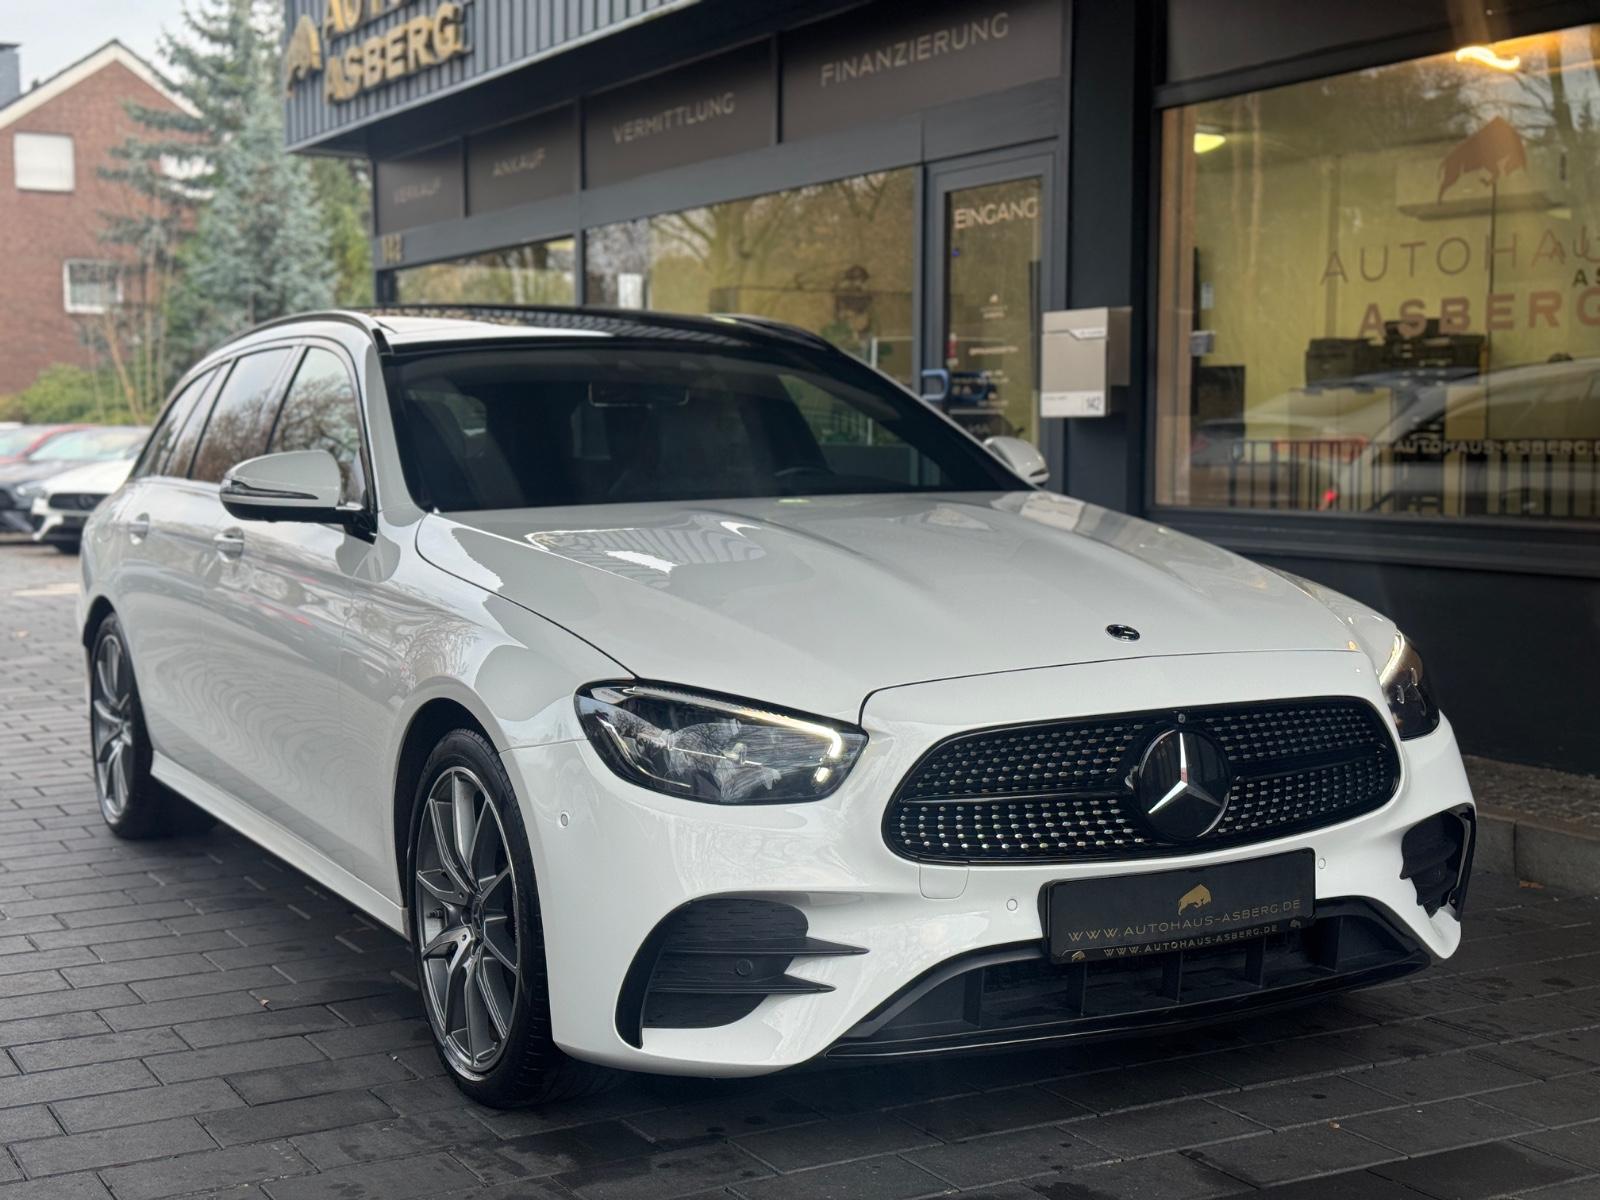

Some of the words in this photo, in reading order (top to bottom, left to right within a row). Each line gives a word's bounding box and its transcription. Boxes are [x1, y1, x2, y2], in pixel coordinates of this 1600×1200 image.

[324, 1, 467, 104] ASBERG
[820, 12, 1009, 87] FINANZIERUNG
[611, 92, 736, 144] VERMITTLUNG
[491, 148, 546, 177] ANKAUF
[953, 196, 1039, 230] EINGANG
[1357, 287, 1600, 339] ASBERG
[1067, 898, 1302, 943] WWW.AUTOHAUS-ASBERG.DE
